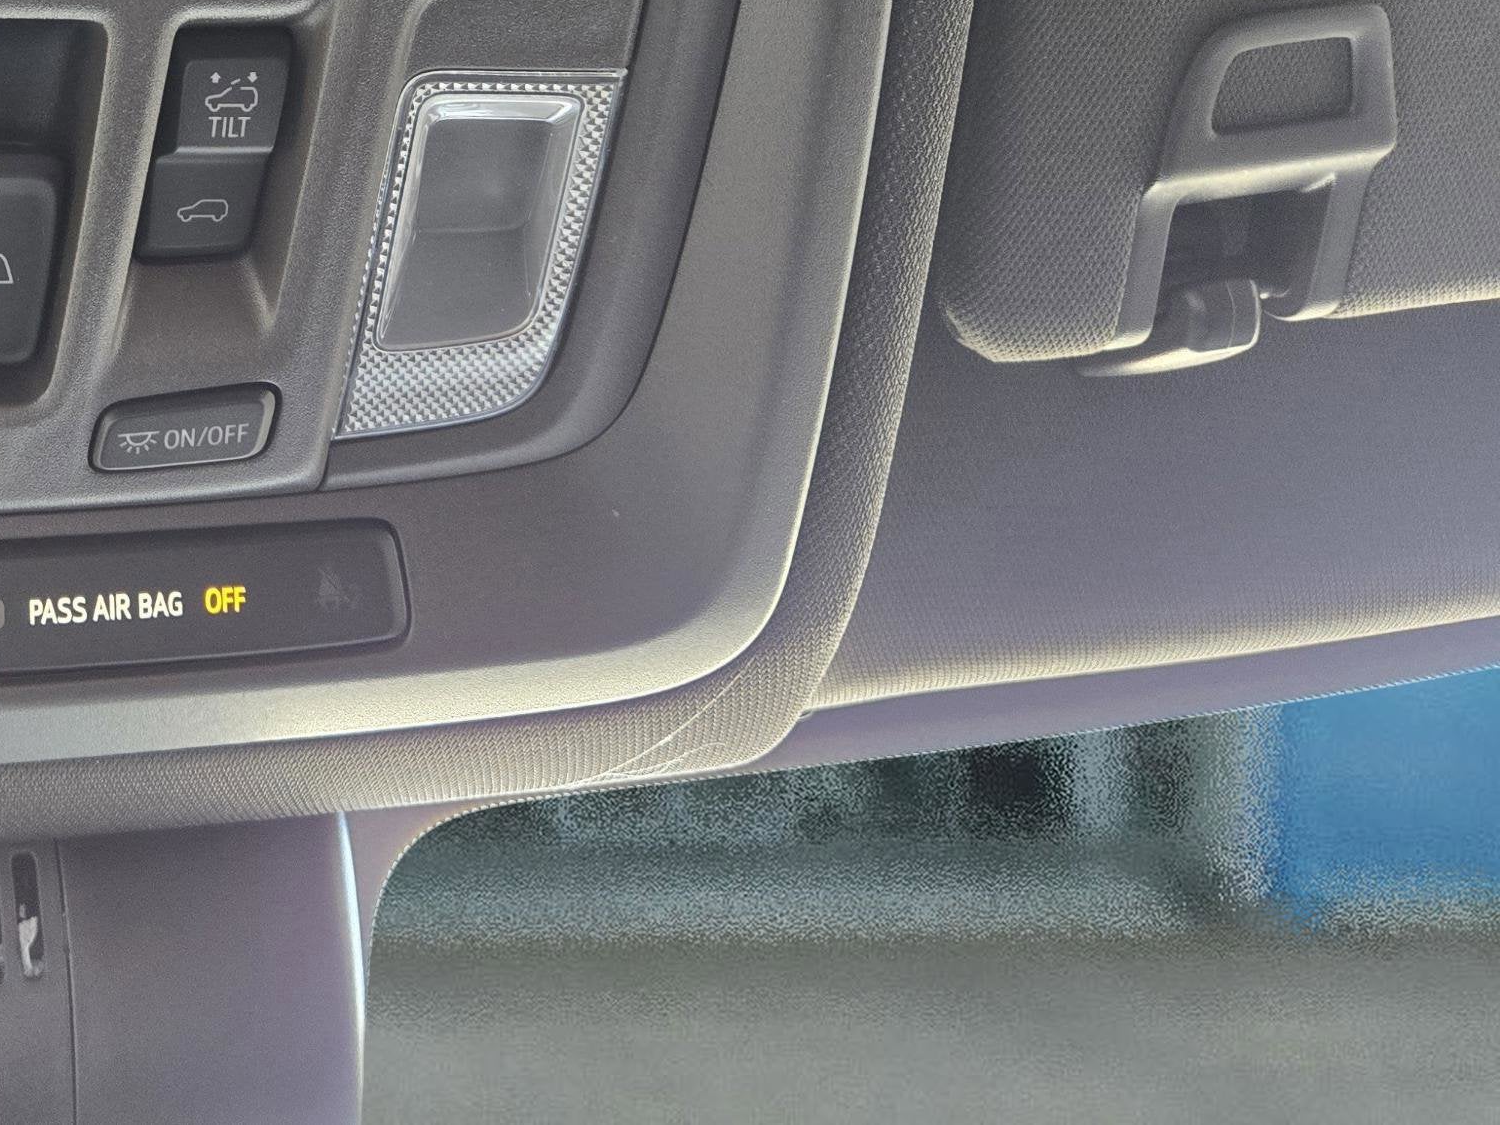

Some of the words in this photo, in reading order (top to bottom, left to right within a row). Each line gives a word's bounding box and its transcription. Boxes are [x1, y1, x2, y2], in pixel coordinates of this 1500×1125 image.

[208, 116, 250, 137] TILT
[164, 423, 249, 449] ON/OFF
[28, 596, 88, 626] PASS
[92, 593, 132, 622] AIR
[137, 591, 183, 619] BAG
[204, 586, 247, 615] OFF
